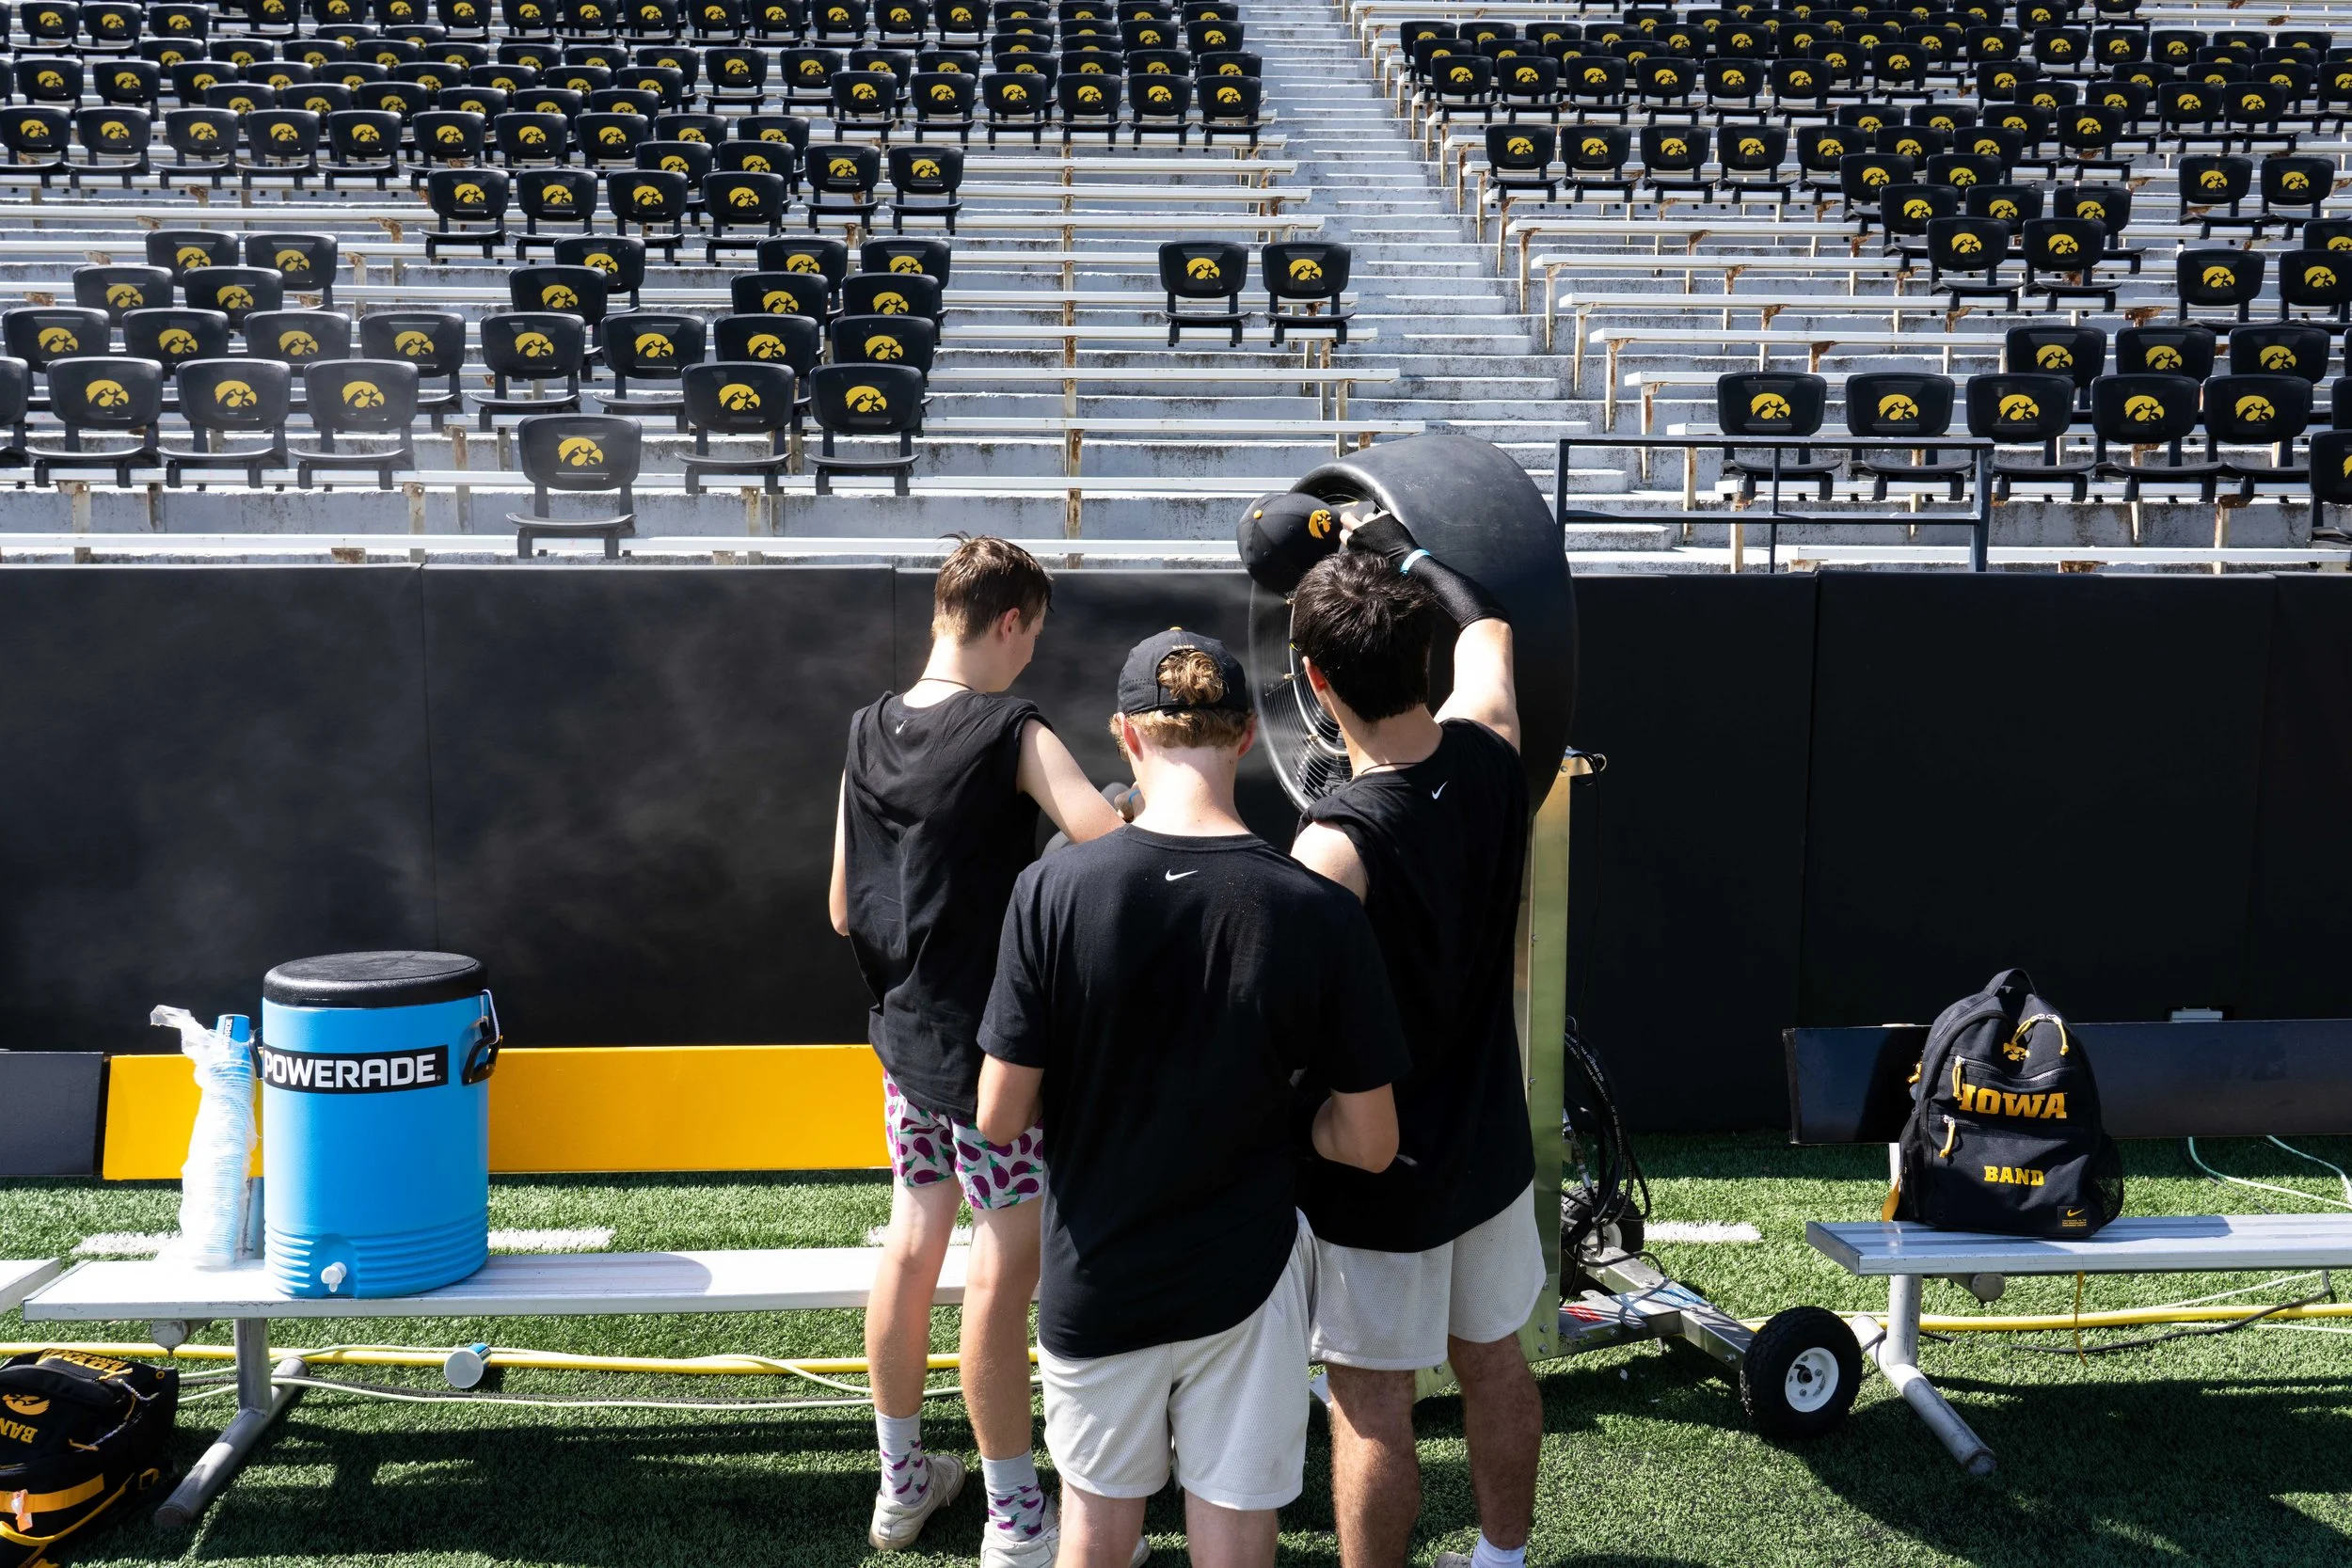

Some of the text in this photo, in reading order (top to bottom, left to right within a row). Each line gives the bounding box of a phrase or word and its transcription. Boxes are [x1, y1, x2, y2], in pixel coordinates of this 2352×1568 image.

[264, 1050, 437, 1088] POWERADE
[1959, 1084, 2067, 1118] IOWA
[1984, 1165, 2045, 1186] BAND
[0, 1418, 38, 1444] BAN
